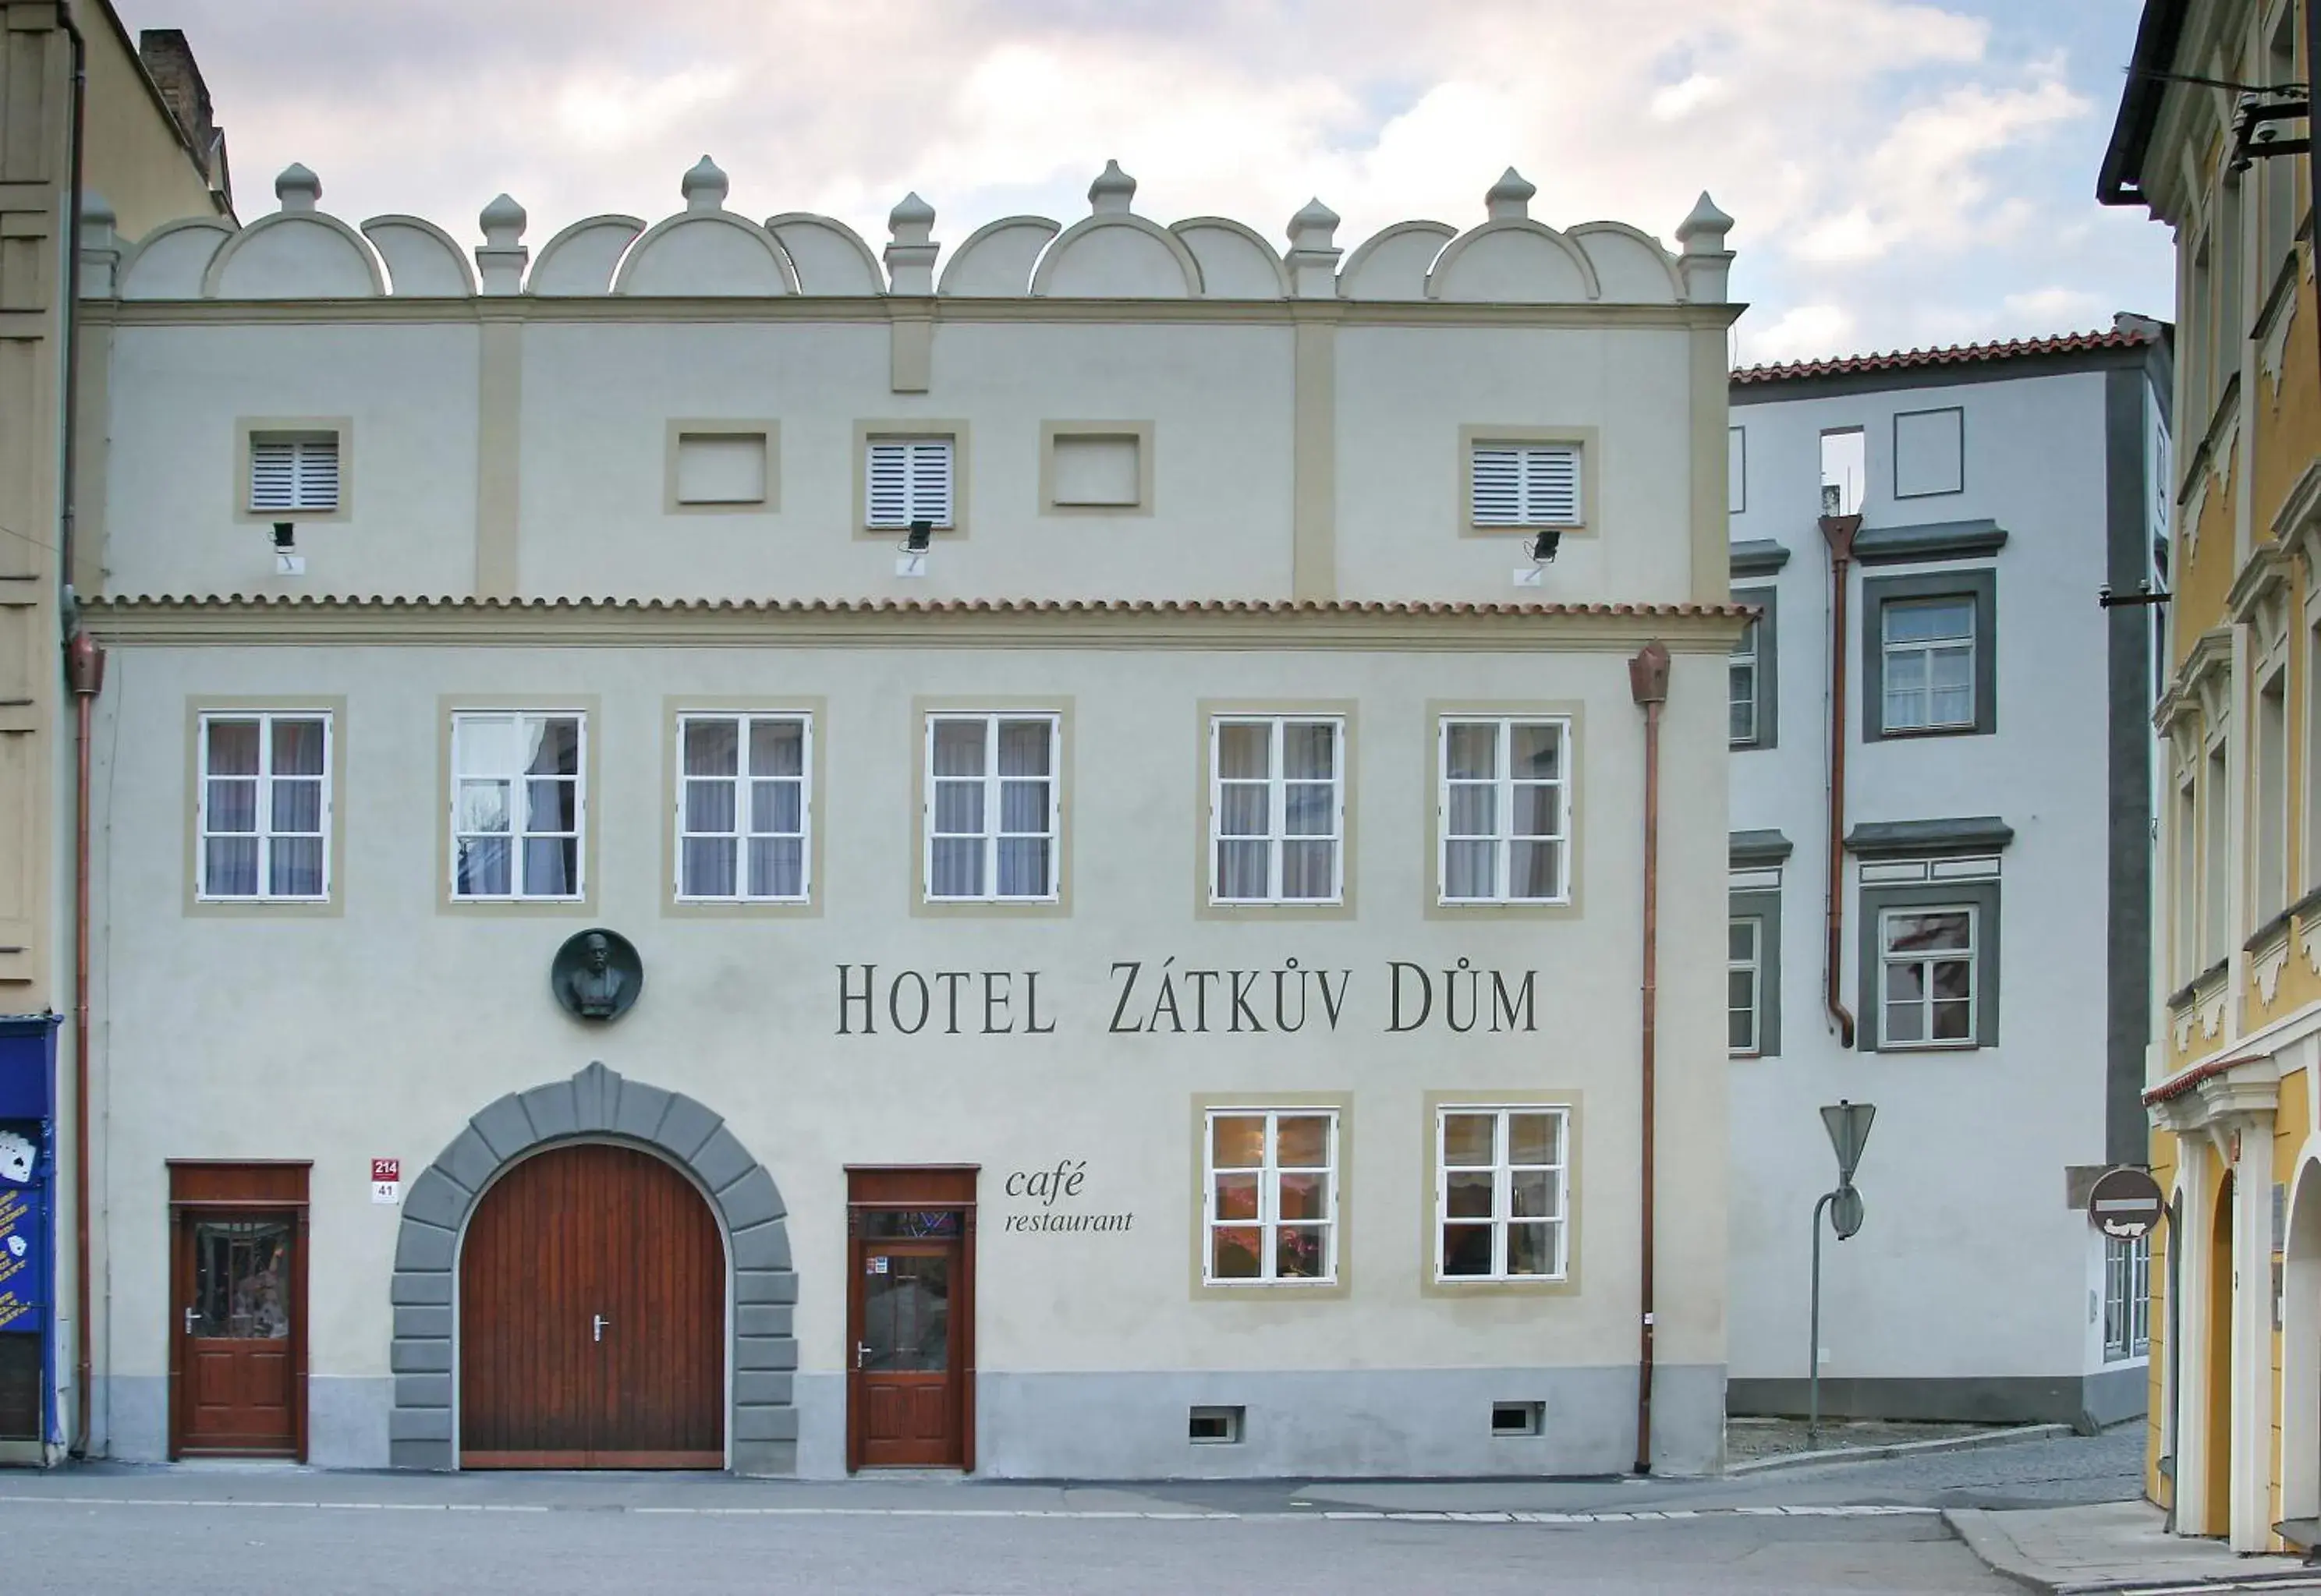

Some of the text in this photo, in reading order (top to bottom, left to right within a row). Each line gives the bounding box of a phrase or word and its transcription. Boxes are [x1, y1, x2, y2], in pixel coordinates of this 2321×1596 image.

[835, 956, 1538, 1035] HOTEL ZÁTKŮV DŮM
[375, 1160, 397, 1173] 214
[378, 1185, 392, 1195] 41
[1005, 1159, 1086, 1206] café
[1005, 1211, 1134, 1232] restaurant
